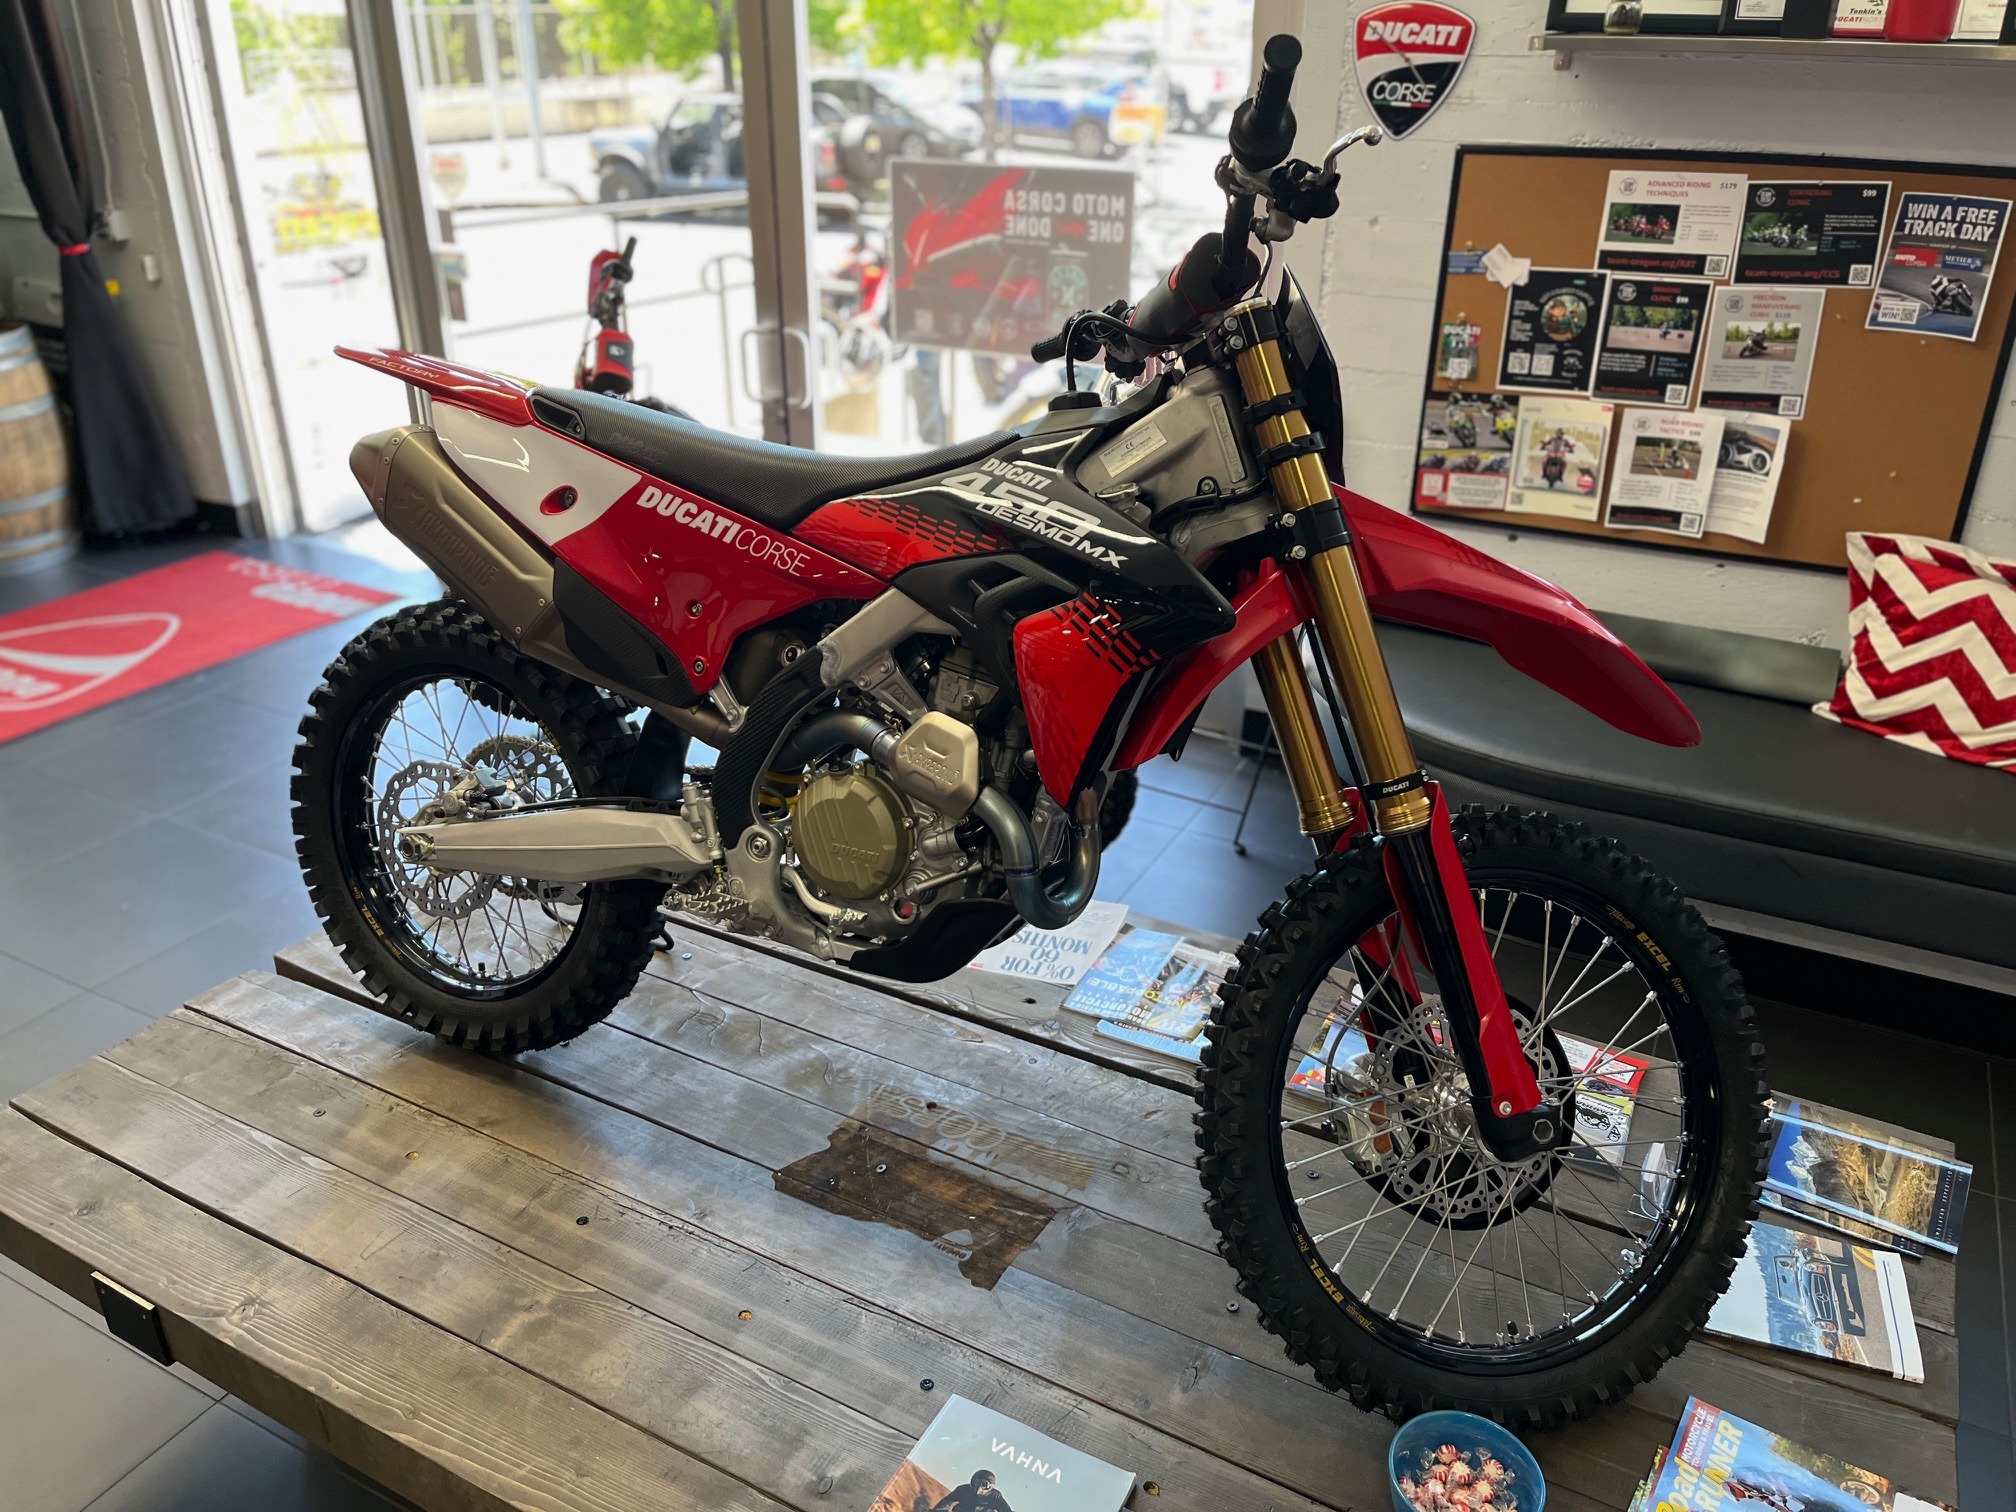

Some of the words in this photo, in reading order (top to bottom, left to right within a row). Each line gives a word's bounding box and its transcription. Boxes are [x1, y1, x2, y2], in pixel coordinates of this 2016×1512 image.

[1363, 20, 1463, 47] DUCATI
[1372, 80, 1437, 103] CORSE
[1646, 190, 1689, 198] TECHNIQUES
[1647, 180, 1685, 188] ADVANCED
[1720, 182, 1738, 190] $179
[1862, 189, 1877, 198] $99
[1907, 203, 1940, 220] WIN
[1940, 205, 1953, 221] A
[1955, 206, 1999, 225] FREE
[1904, 219, 1959, 238] TRACK
[1960, 223, 1994, 242] DAY
[1945, 255, 1972, 264] METIER
[1881, 311, 1901, 320] WIN!
[369, 357, 440, 378] FACTORY
[980, 457, 1052, 490] DUCATI
[636, 485, 742, 544] DUCATI
[735, 528, 811, 577] CORSE
[1382, 780, 1410, 794] DUCATI
[362, 904, 384, 937] EXCEL
[1011, 930, 1093, 955] MONTHS
[1636, 931, 1672, 972] EXCEL
[1000, 955, 1043, 976] FOR
[1030, 947, 1060, 963] 60
[1043, 963, 1075, 980] 0%
[1074, 993, 1152, 1018] MOTORCYCLE
[1297, 1234, 1310, 1253] Rim
[1310, 1258, 1346, 1303] EXCEL
[1681, 1407, 1707, 1463] MOTORCYCLE
[1691, 1440, 1706, 1467] TOURING
[1702, 1415, 1715, 1437] TRAVEL
[990, 1437, 1063, 1485] VAHNA
[1695, 1420, 1744, 1512] RUNNER
